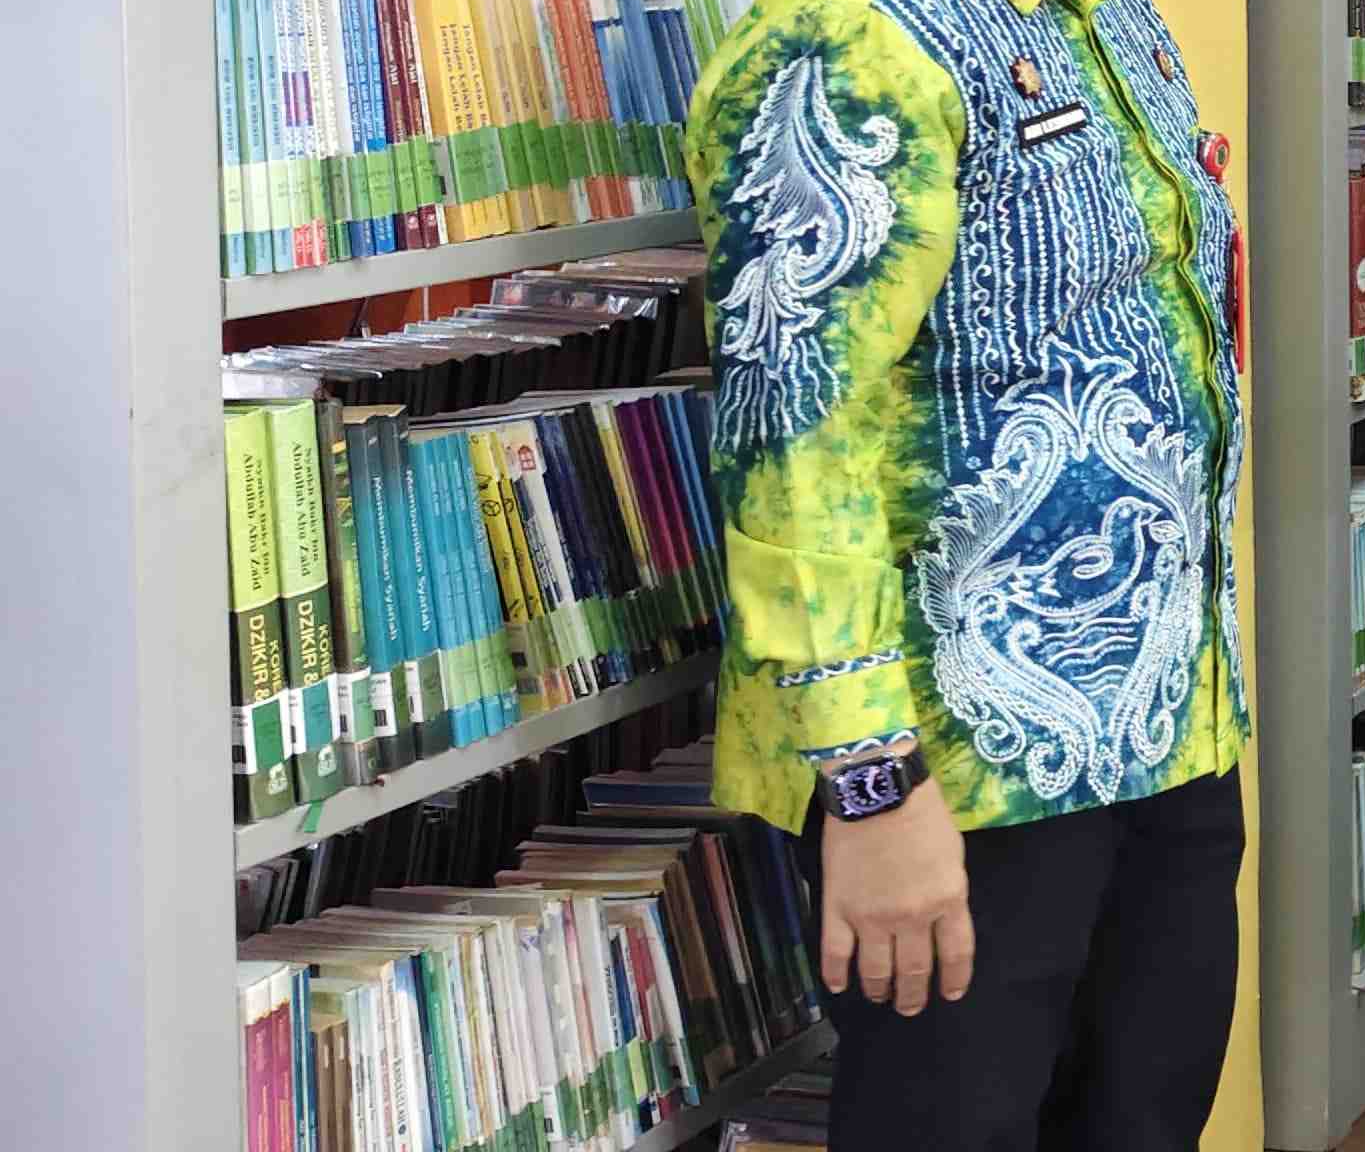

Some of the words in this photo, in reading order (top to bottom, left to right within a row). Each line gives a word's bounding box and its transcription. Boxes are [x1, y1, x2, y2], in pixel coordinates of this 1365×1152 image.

[242, 452, 257, 519] Abdullah
[292, 440, 307, 505] Abdullah
[247, 521, 259, 553] Abu
[296, 510, 308, 540] Abu
[249, 558, 262, 591] Zaid
[299, 544, 311, 577] Zaid
[248, 613, 269, 680] DZIKIR
[297, 599, 318, 667] DZIKIR
